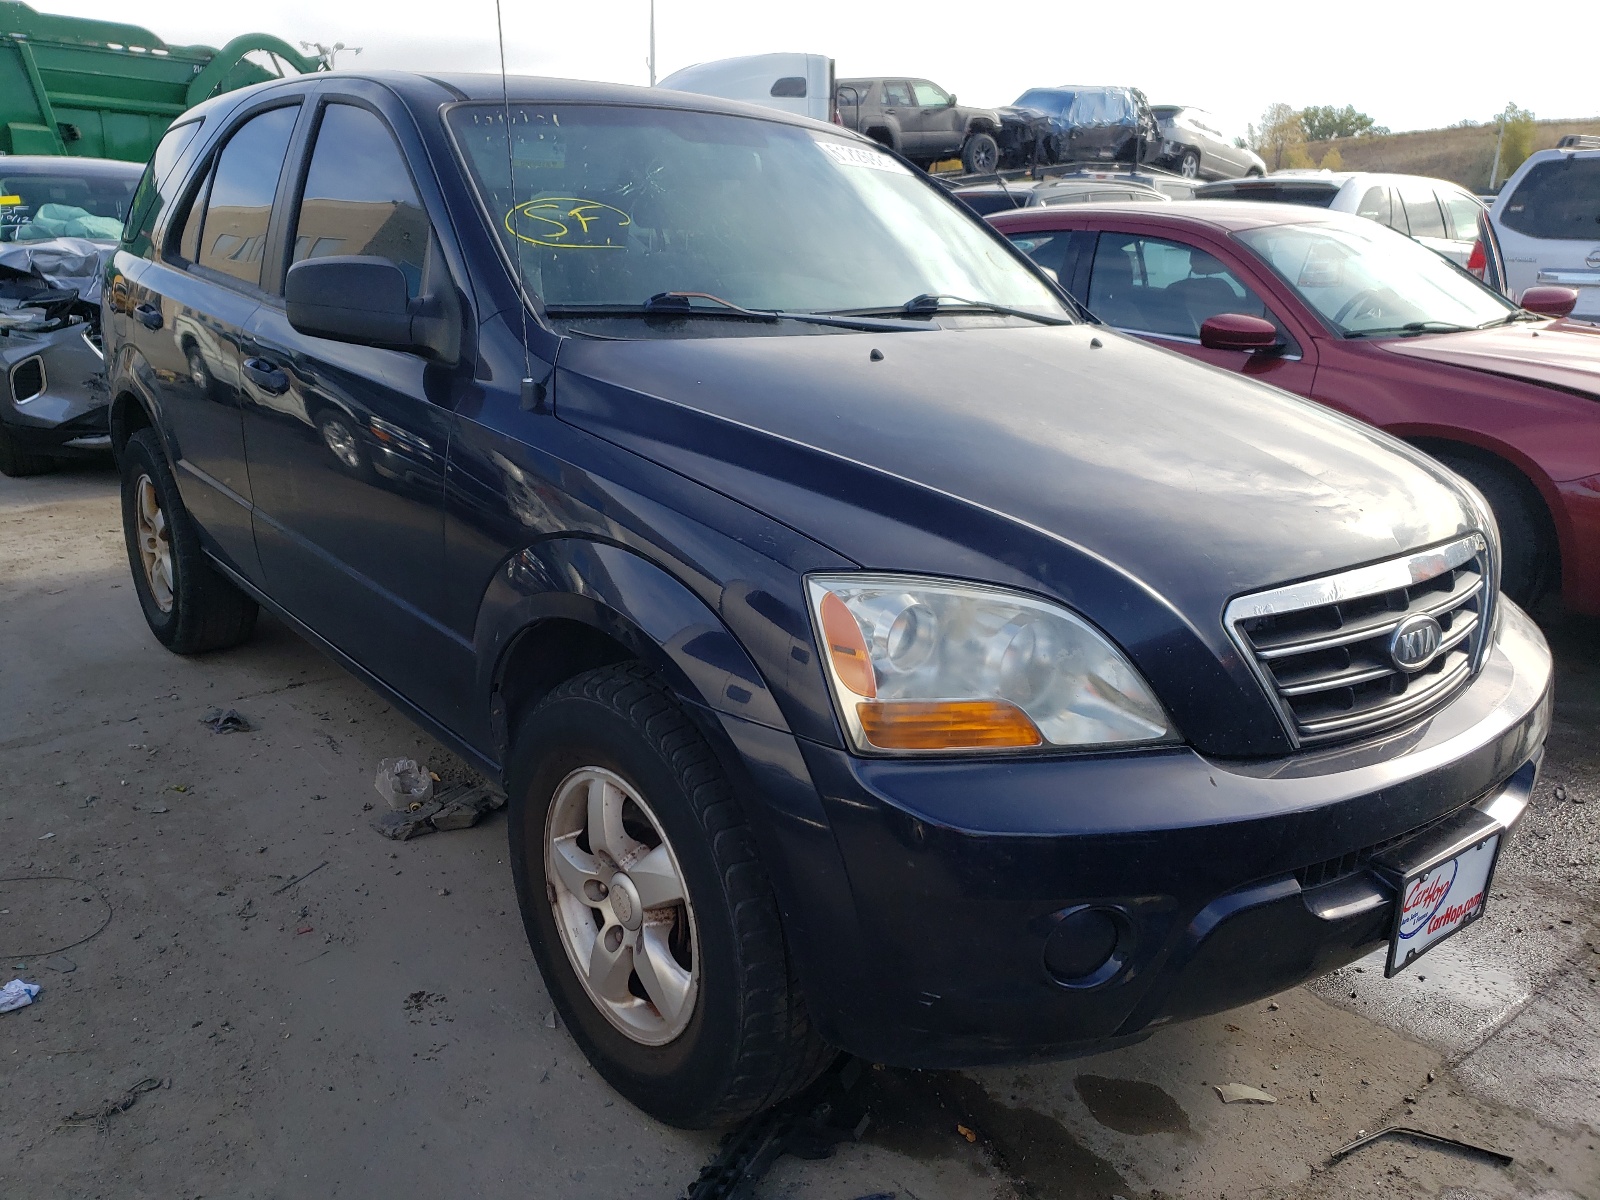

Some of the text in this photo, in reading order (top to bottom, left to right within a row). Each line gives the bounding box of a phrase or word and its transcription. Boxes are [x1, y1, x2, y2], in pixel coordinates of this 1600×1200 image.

[523, 203, 604, 238] SF
[1401, 625, 1436, 661] KIA
[1403, 874, 1450, 913] CarHop
[1427, 891, 1484, 935] CarHop.com
